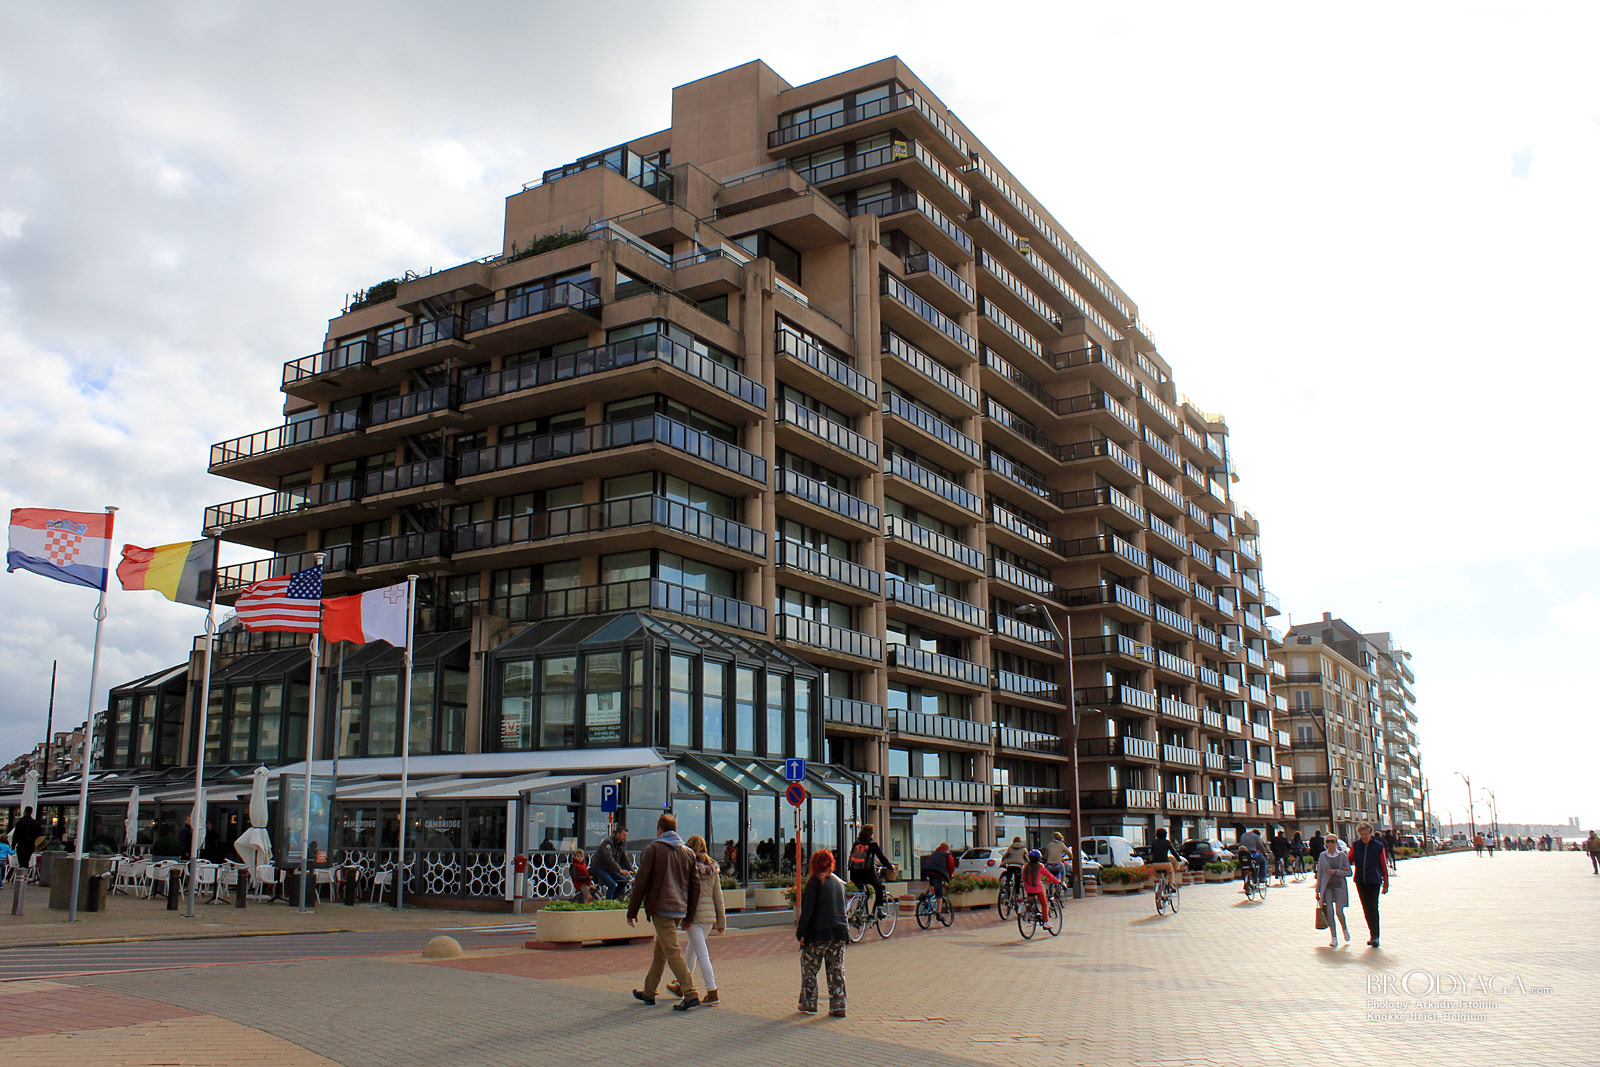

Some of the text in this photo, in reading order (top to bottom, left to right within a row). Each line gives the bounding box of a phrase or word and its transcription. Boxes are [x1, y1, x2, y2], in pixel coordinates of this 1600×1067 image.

[604, 786, 613, 801] P
[343, 820, 376, 828] CAMBRIDGE
[424, 820, 461, 828] CAMBRIDGE
